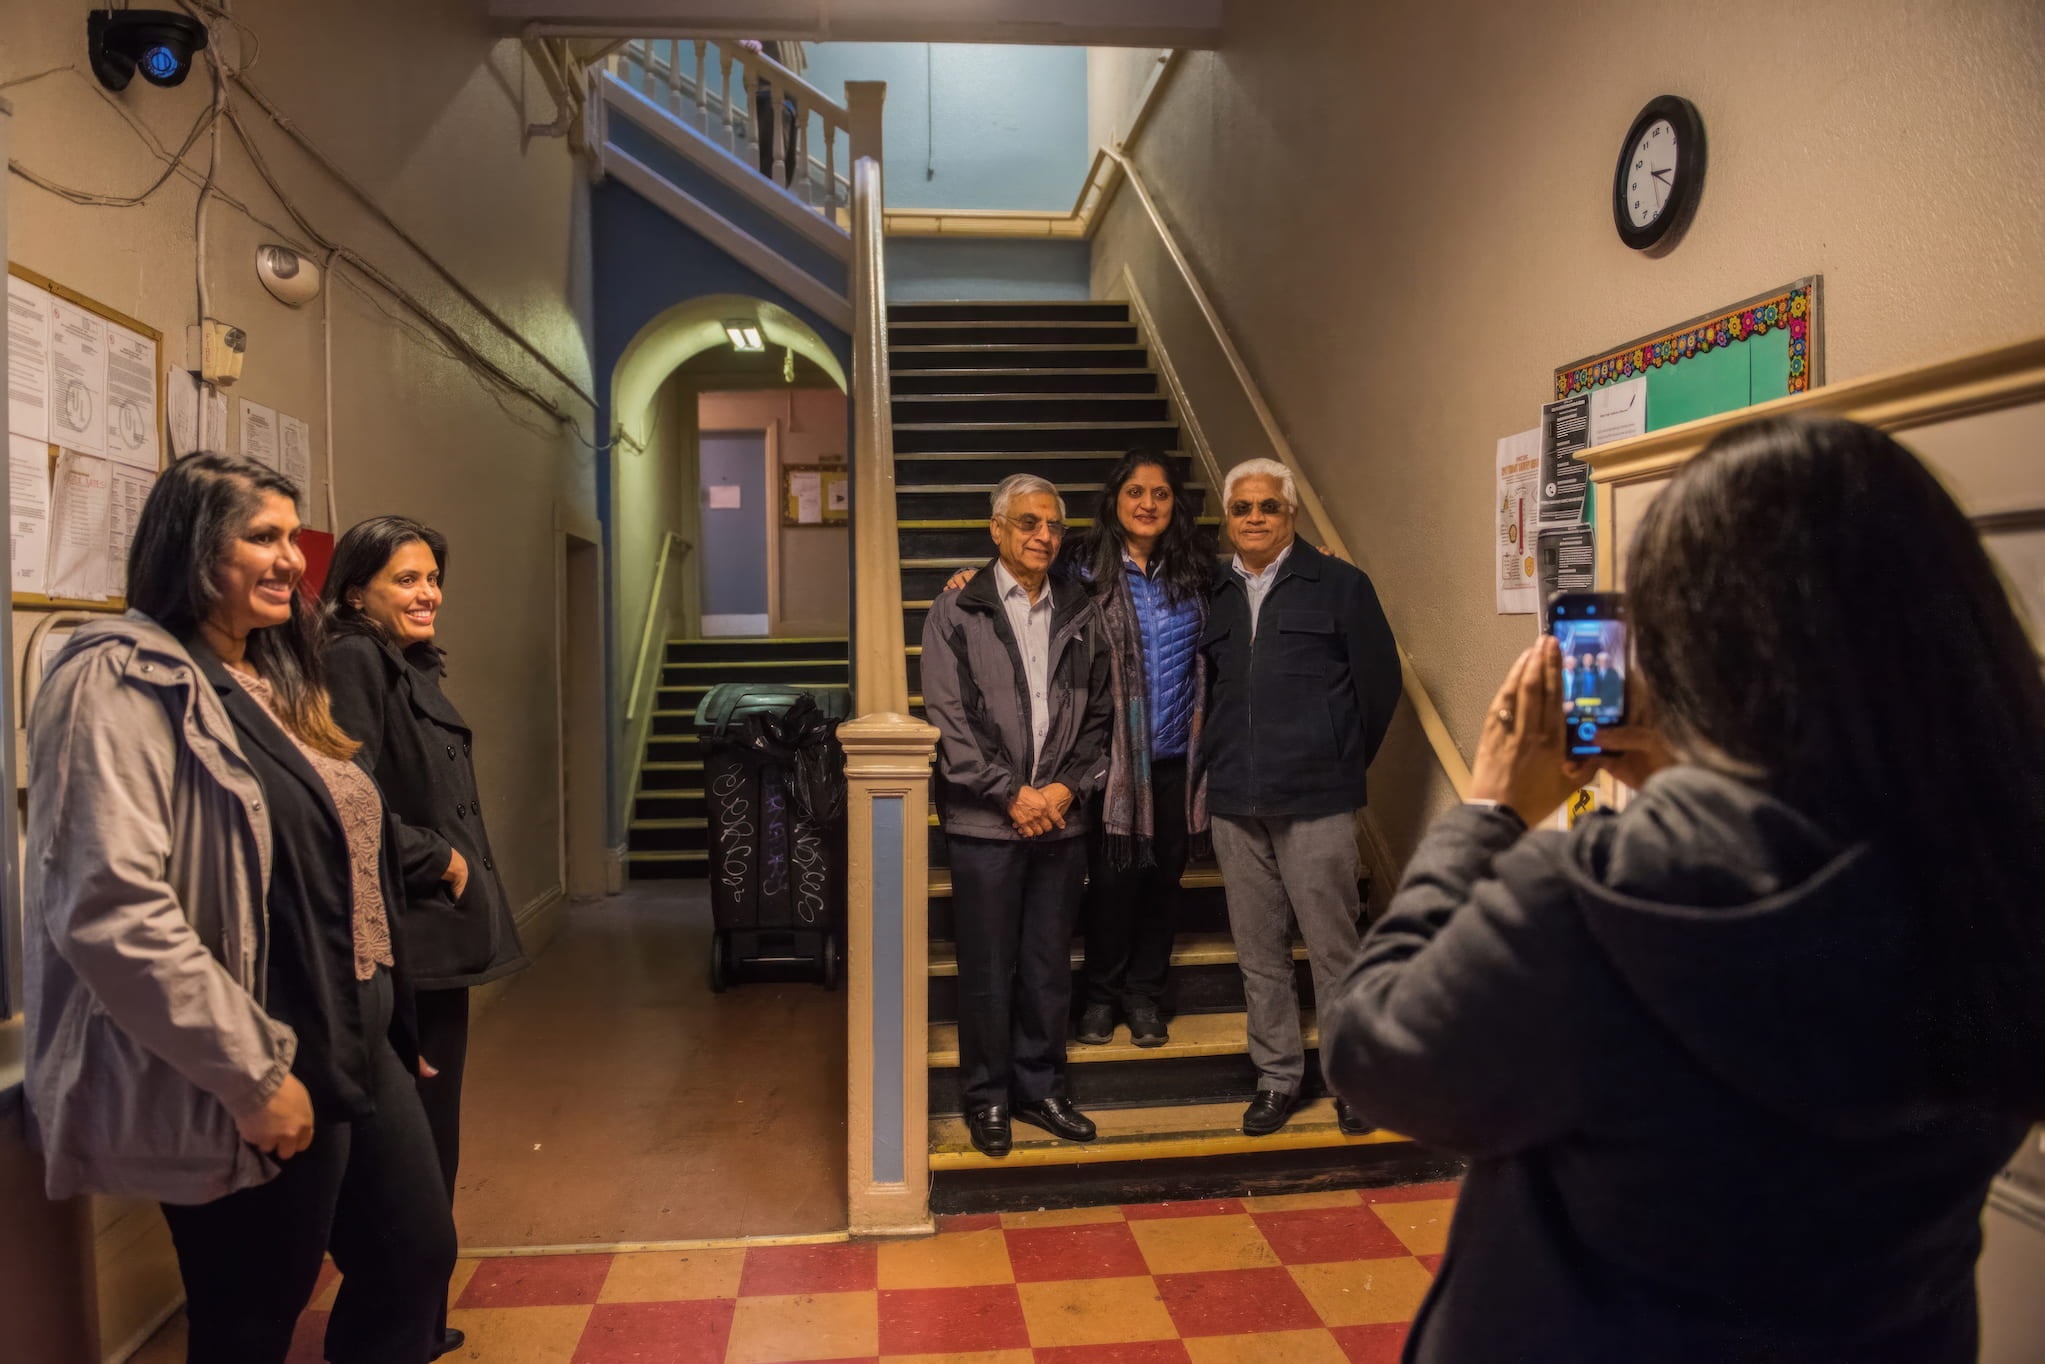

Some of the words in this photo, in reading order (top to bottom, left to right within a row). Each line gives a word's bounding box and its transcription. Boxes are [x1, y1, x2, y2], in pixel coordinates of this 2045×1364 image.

[1652, 127, 1660, 138] 12
[1643, 140, 1649, 151] 11
[1636, 160, 1643, 170] 10
[1632, 183, 1637, 191] 9
[1635, 200, 1640, 209] 8
[1642, 210, 1648, 219] 7
